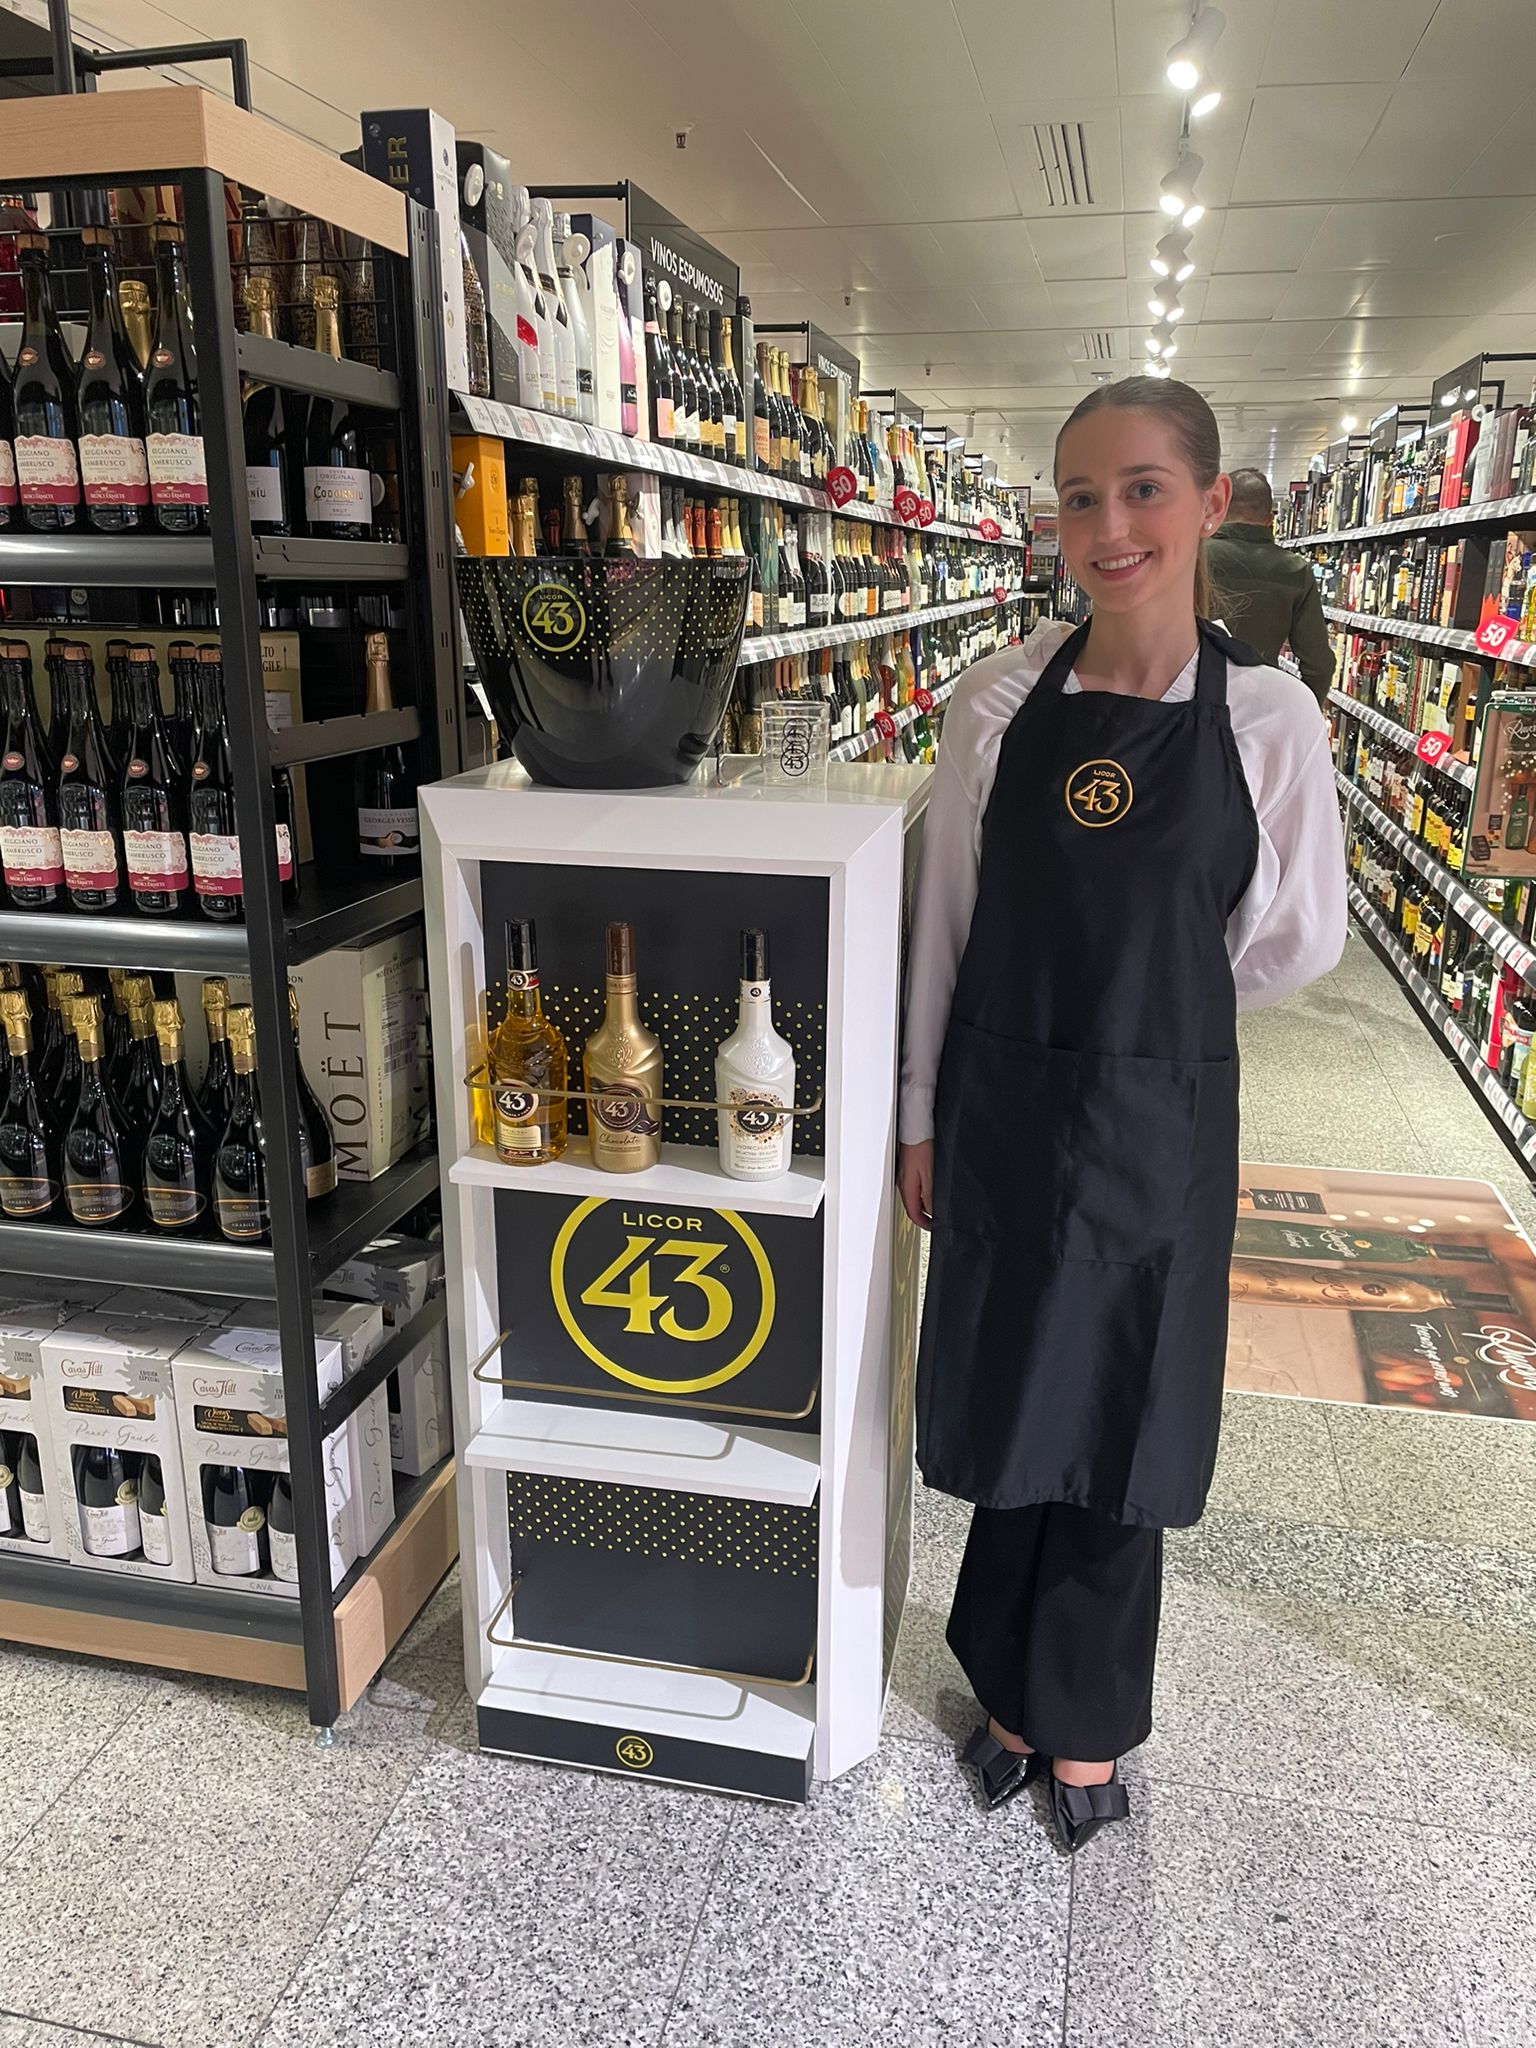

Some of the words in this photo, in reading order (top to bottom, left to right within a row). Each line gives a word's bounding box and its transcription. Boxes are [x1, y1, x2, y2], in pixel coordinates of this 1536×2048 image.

[387, 136, 409, 185] ER
[650, 236, 678, 276] VINOS
[678, 256, 724, 306] ESPUMOSOS
[319, 473, 356, 482] ORIGINAL
[899, 497, 917, 516] 50
[531, 601, 574, 635] 43
[261, 646, 275, 658] TO
[262, 660, 282, 672] GILE
[784, 756, 804, 770] 43
[1093, 769, 1117, 779] LICOR
[1073, 778, 1121, 815] 43
[510, 975, 524, 986] 43
[319, 1011, 368, 1178] MOËT
[498, 1090, 526, 1111] 43
[604, 1100, 629, 1118] 43
[598, 1132, 641, 1146] Chocolate
[736, 1143, 777, 1151] HORCHATA
[621, 1211, 704, 1232] LICOR
[579, 1234, 734, 1343] 43
[60, 1358, 87, 1379] Cavas
[83, 1360, 104, 1379] Hill
[138, 1375, 160, 1383] ESPECIAL
[192, 1377, 219, 1399] Cavas
[215, 1378, 237, 1398] Hill
[363, 1397, 382, 1447] Gaud
[322, 1433, 343, 1487] Gaud
[120, 1563, 144, 1574] CAVA
[249, 1582, 274, 1592] CAVA
[621, 1743, 647, 1762] 43
